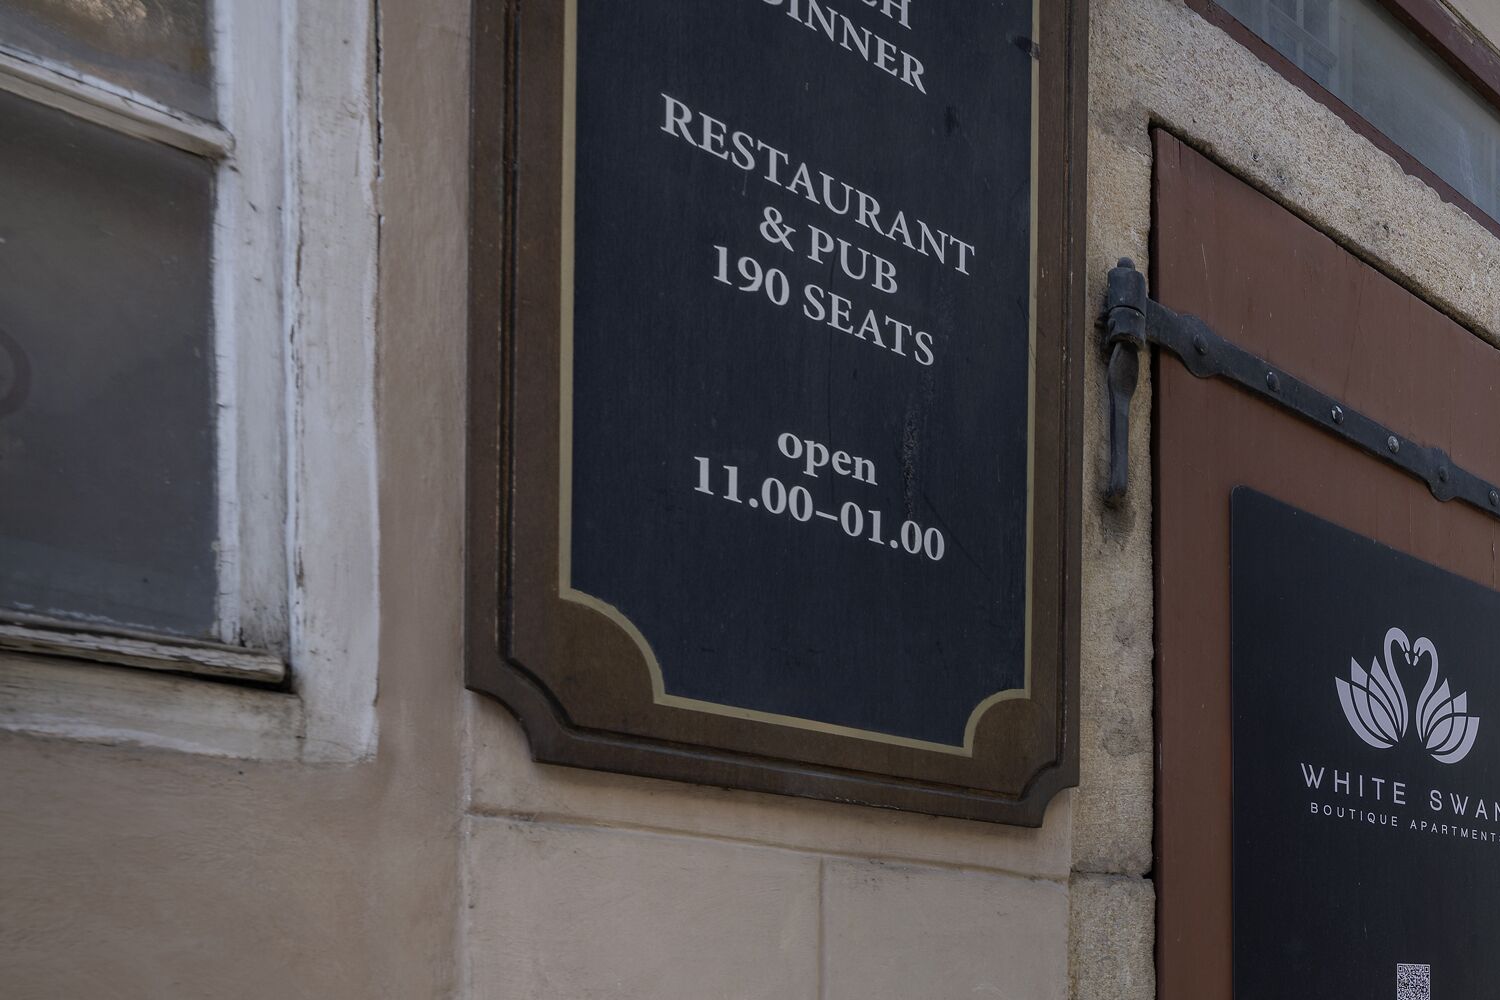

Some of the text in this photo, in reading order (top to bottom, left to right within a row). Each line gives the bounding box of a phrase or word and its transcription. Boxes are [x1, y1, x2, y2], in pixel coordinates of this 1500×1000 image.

[762, 0, 927, 95] INNER
[660, 92, 976, 276] RESTAURANT
[759, 206, 898, 294] & PUB
[712, 245, 935, 366] 190 SEATS
[777, 432, 878, 486] open
[1300, 762, 1406, 806] WHITE
[1310, 802, 1398, 827] BOUTIQUE
